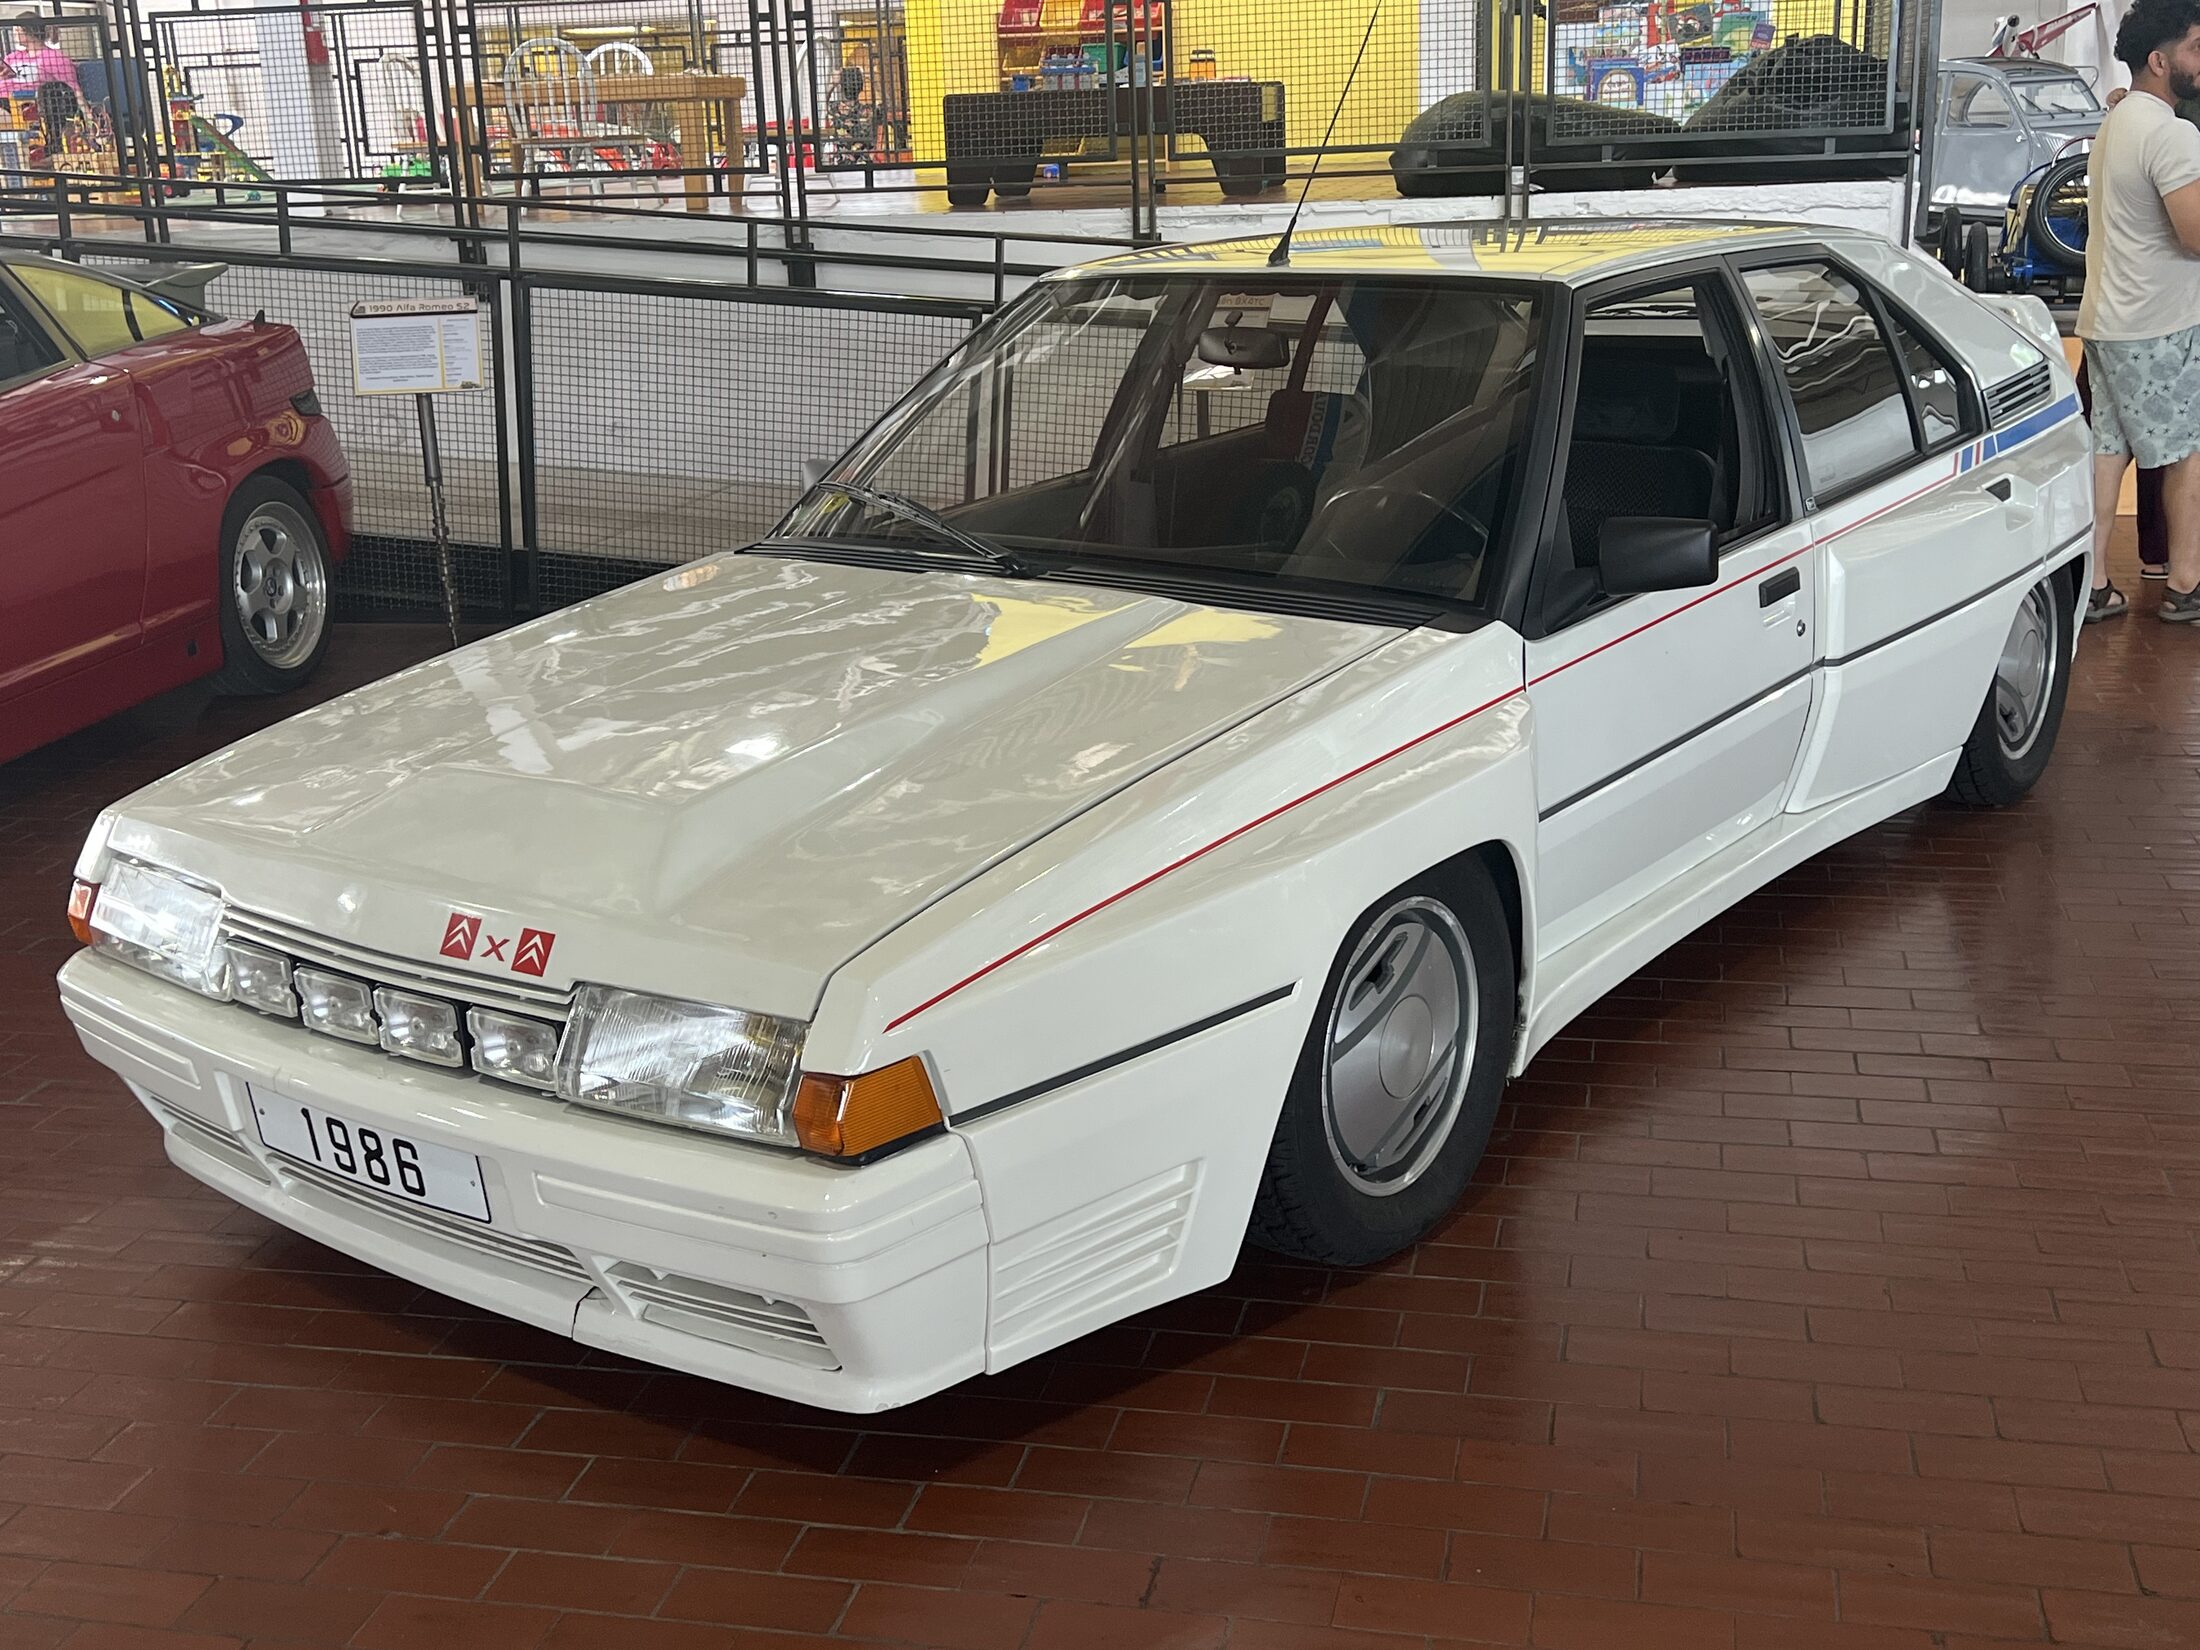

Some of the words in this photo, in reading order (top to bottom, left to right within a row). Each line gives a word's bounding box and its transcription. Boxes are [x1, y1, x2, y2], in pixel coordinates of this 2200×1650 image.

[369, 304, 393, 313] 1990
[396, 303, 416, 312] Alfa
[418, 302, 454, 312] Romeo
[300, 1107, 426, 1197] 1986
